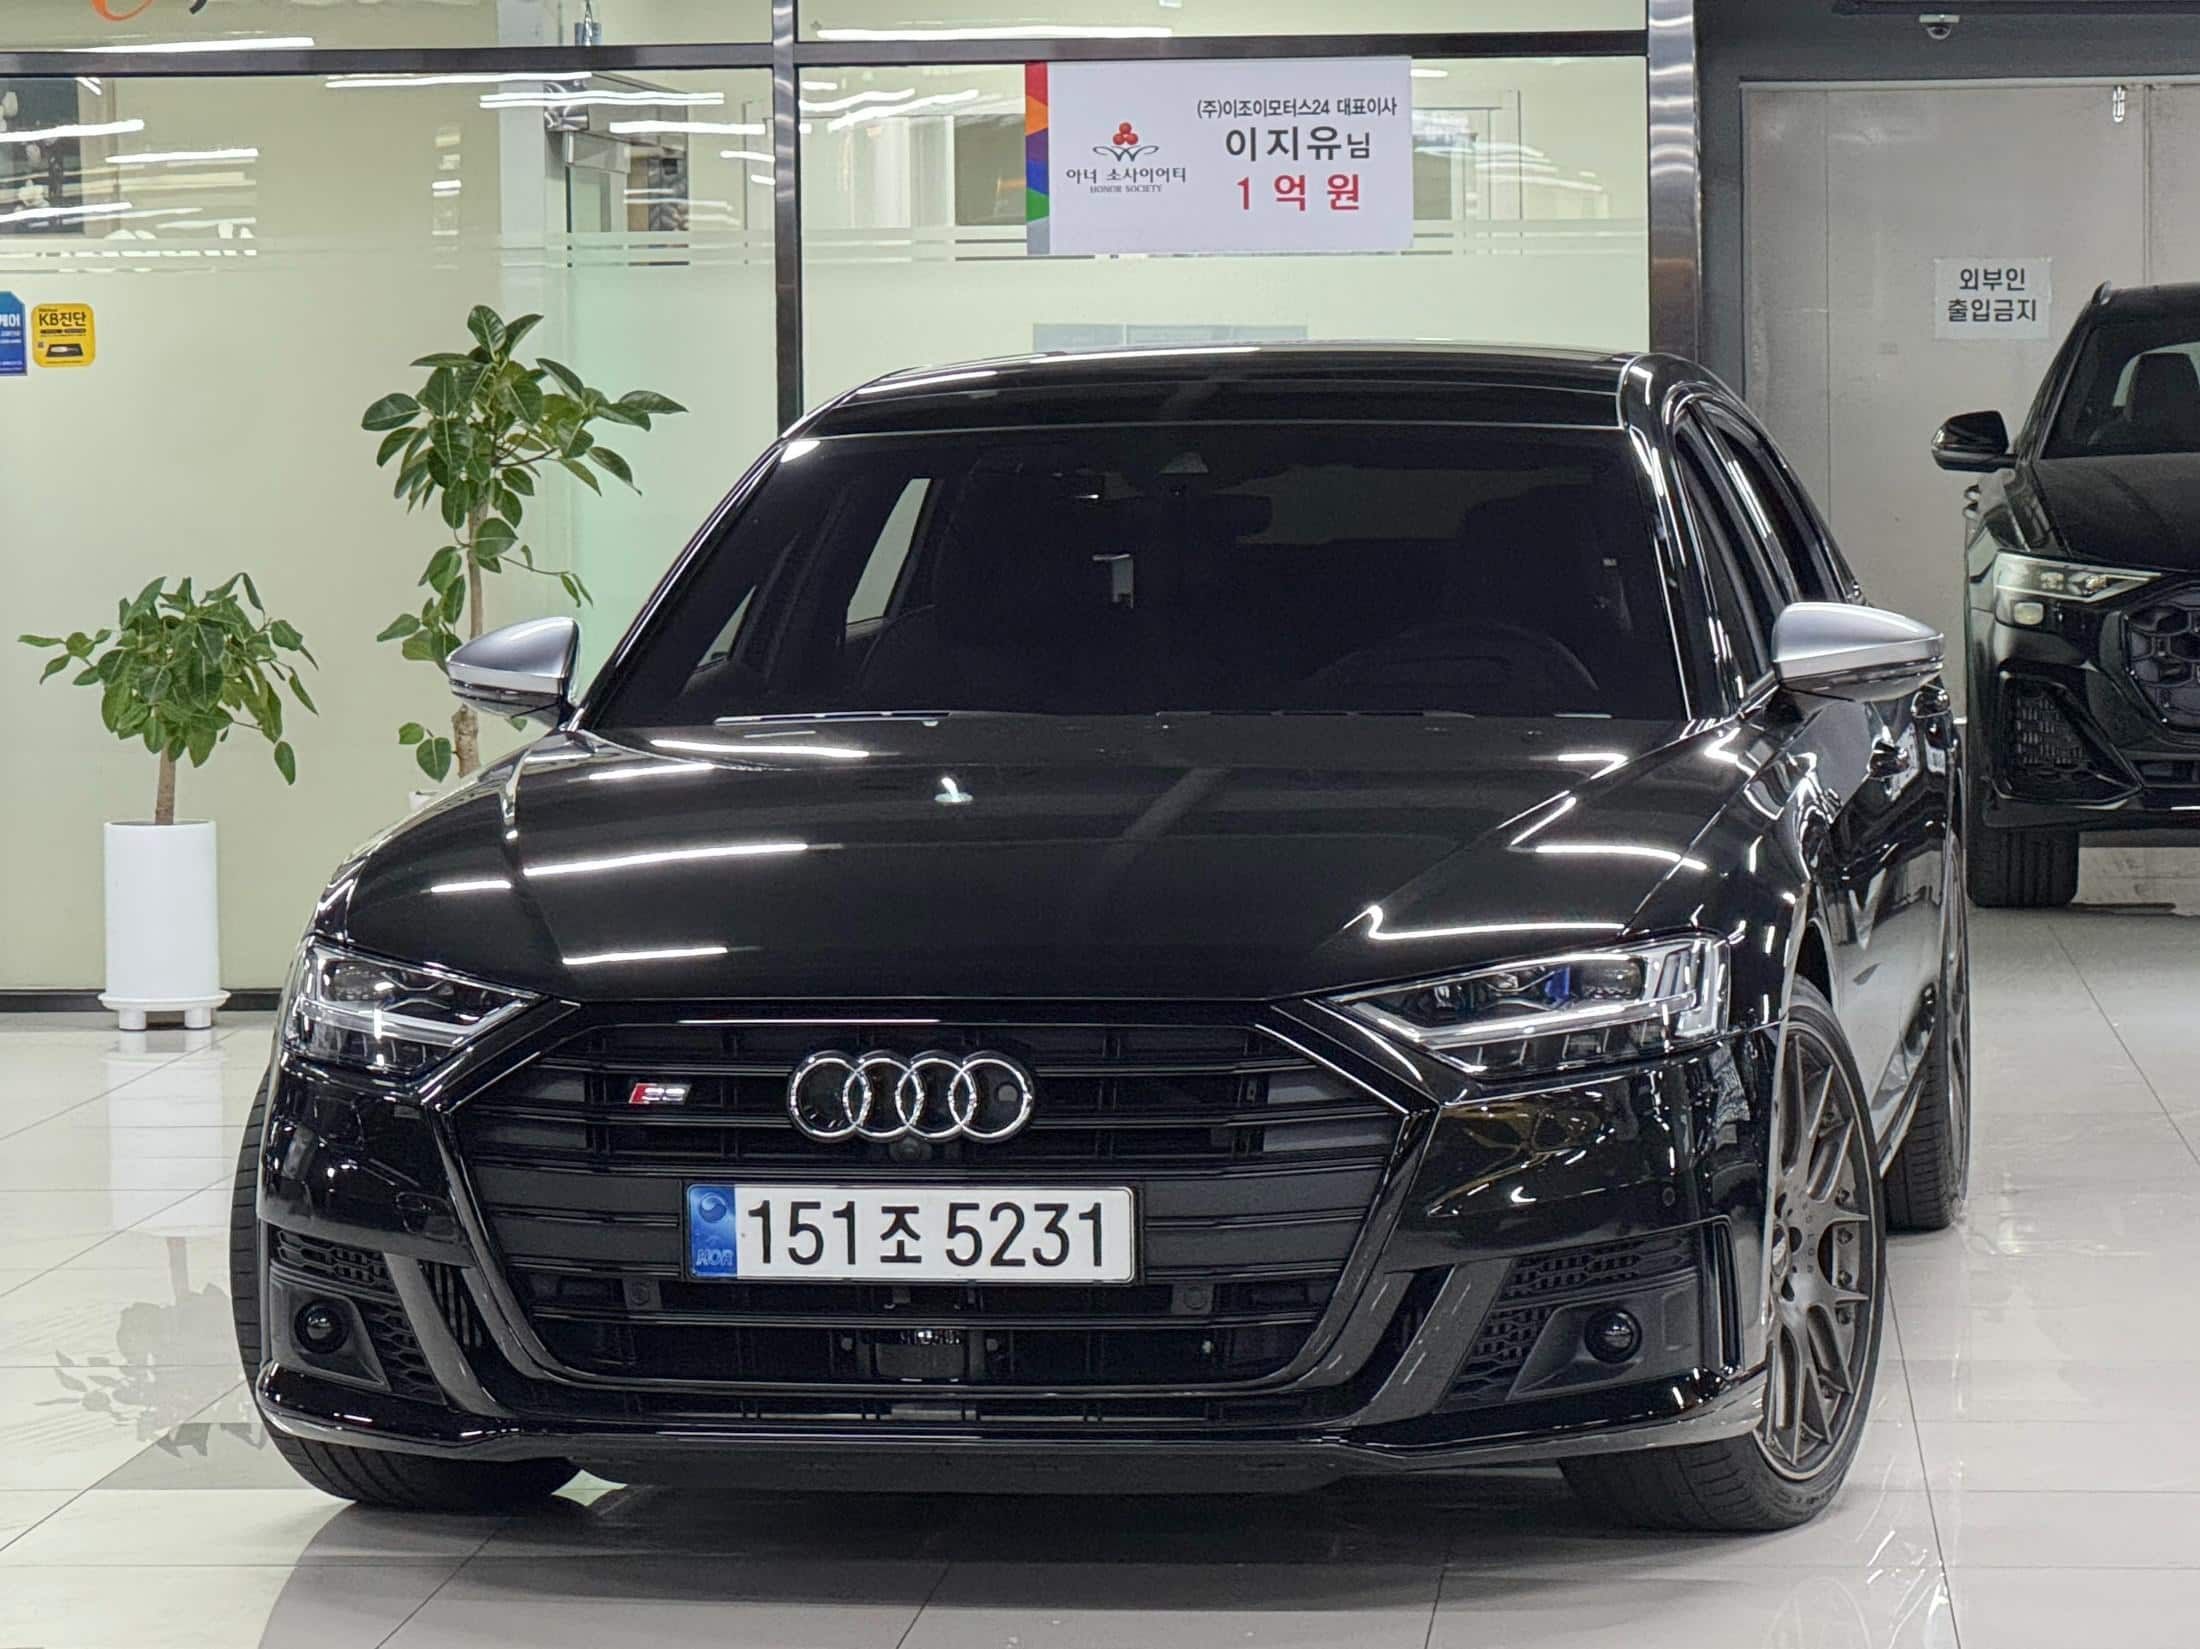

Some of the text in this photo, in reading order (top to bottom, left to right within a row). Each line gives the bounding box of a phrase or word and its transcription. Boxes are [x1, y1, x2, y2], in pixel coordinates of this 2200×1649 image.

[1197, 97, 1397, 118] (주)이조이모터스24 대표이사
[1066, 167, 1187, 184] 아너 소사이어티
[1090, 184, 1162, 193] HONOR SOCIETY
[1959, 267, 2025, 291] 외부인
[39, 311, 87, 327] KB진단
[1947, 298, 2037, 322] 출입금지
